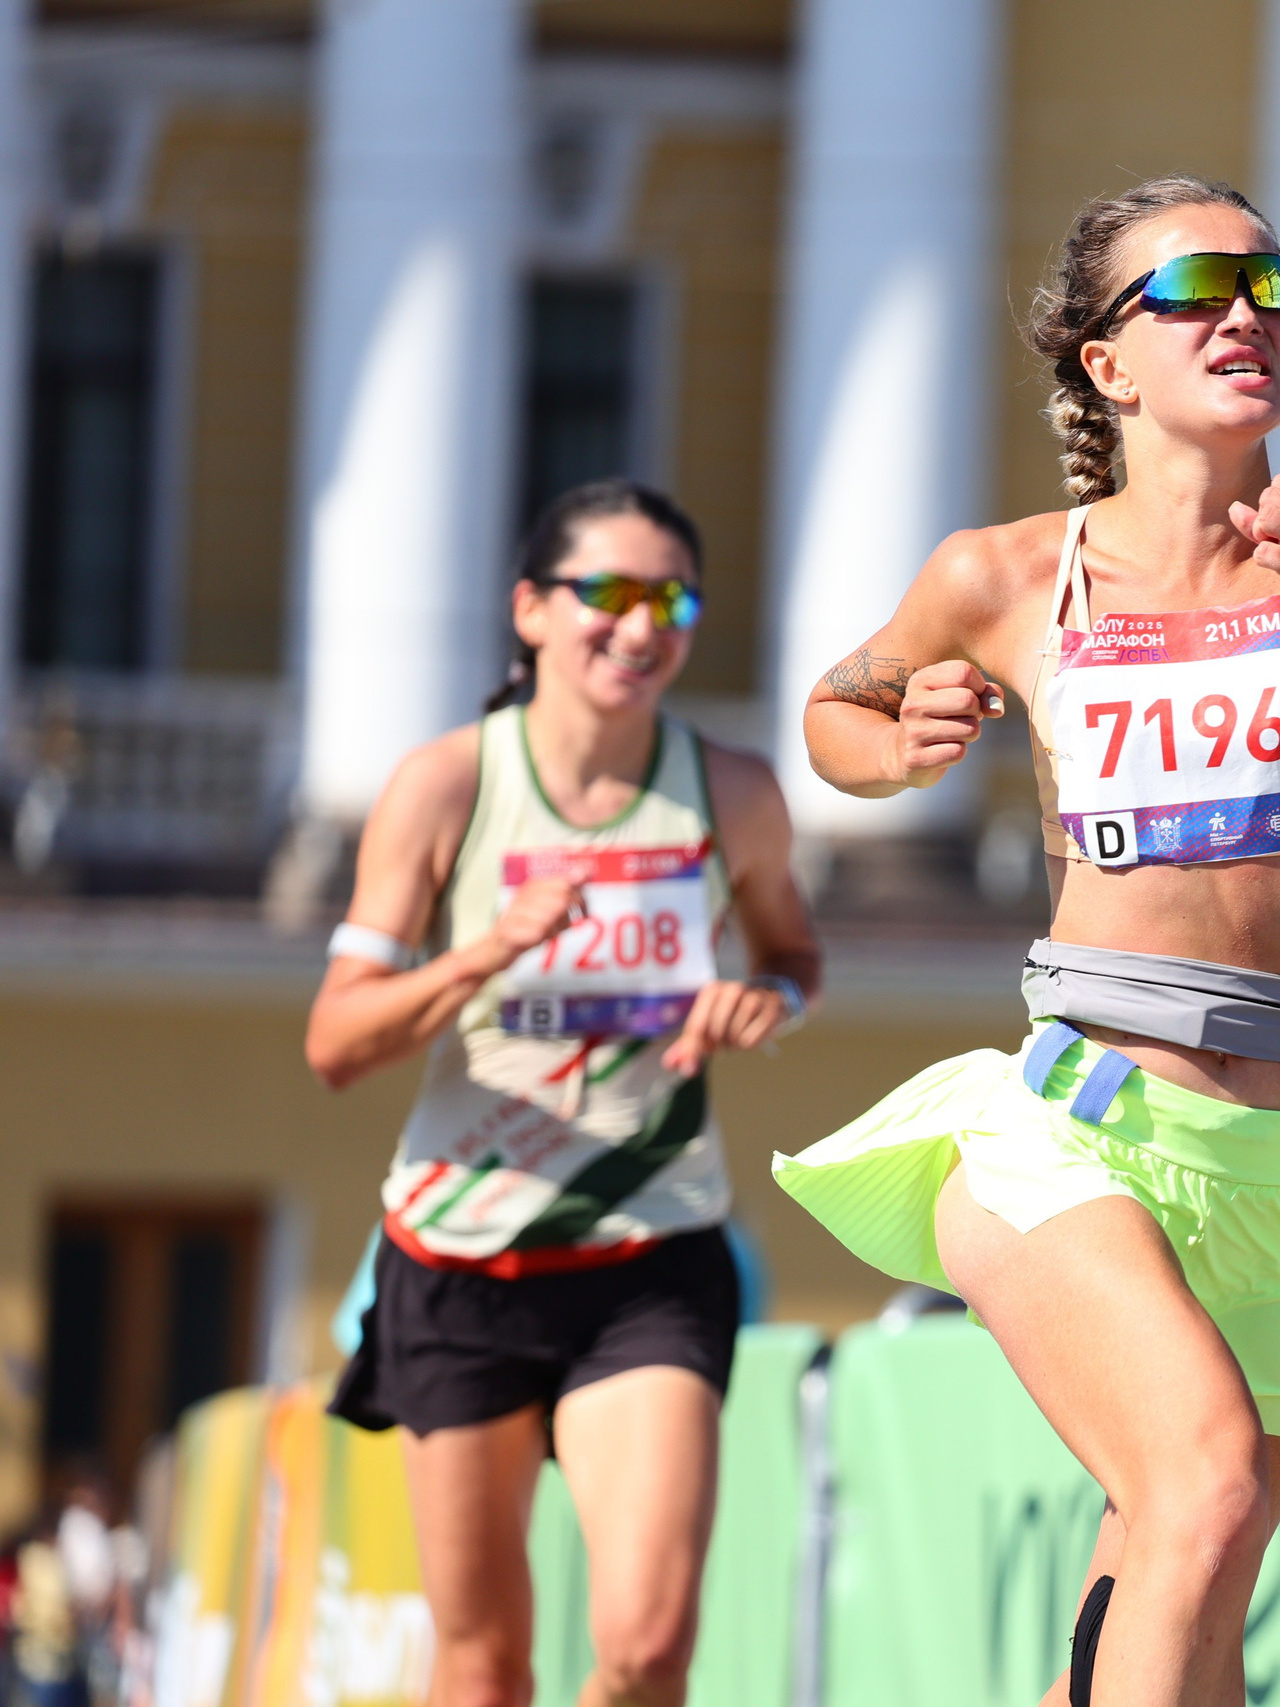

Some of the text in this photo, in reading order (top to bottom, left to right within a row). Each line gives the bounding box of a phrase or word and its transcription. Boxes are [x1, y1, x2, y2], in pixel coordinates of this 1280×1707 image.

[1093, 619, 1163, 632] ОЛУ 2025
[1205, 619, 1240, 642] 21,1
[1095, 820, 1125, 859] D
